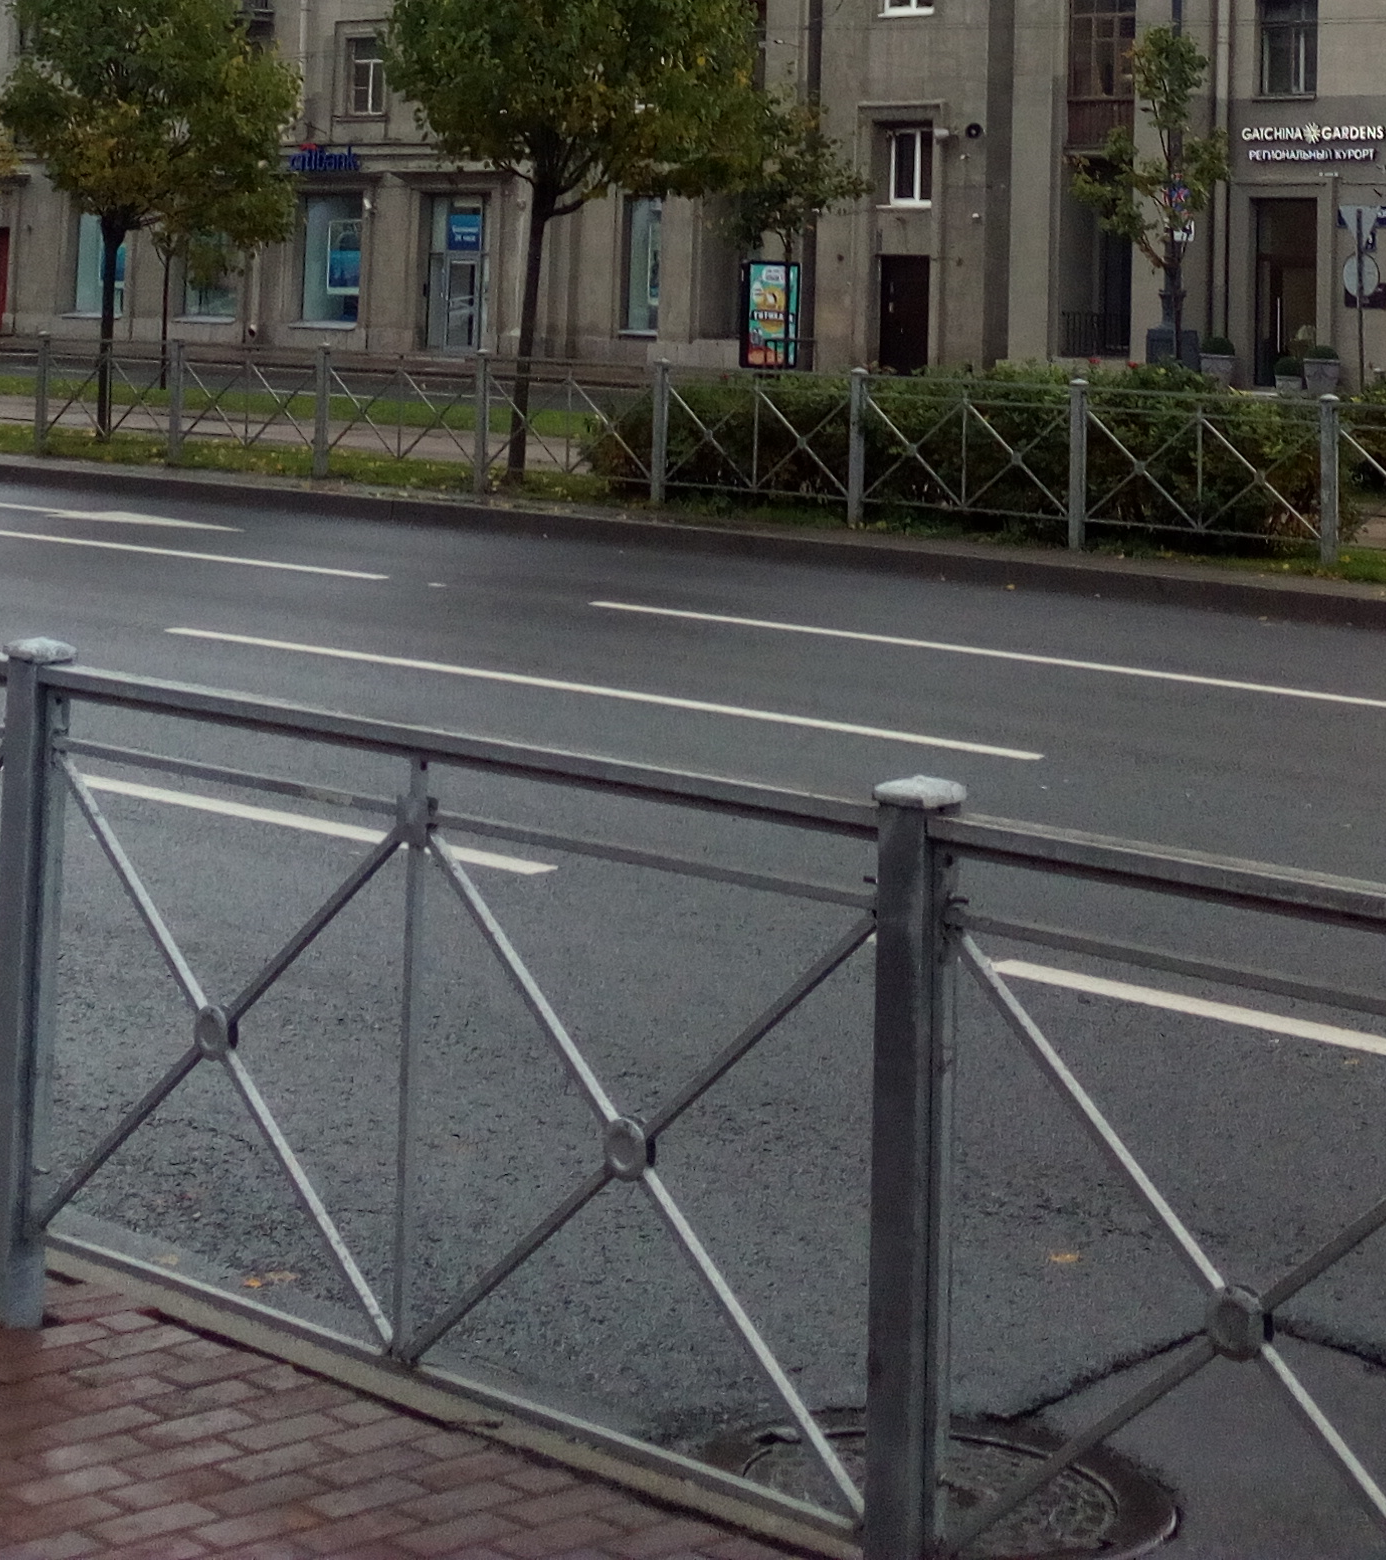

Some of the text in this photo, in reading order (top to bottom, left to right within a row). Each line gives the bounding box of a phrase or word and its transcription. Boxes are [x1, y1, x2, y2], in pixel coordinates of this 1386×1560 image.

[1241, 125, 1385, 141] GATCHINA GARDENS
[1248, 147, 1375, 161] РЕГИОНАЛЬНЫЙ КУРОРТ
